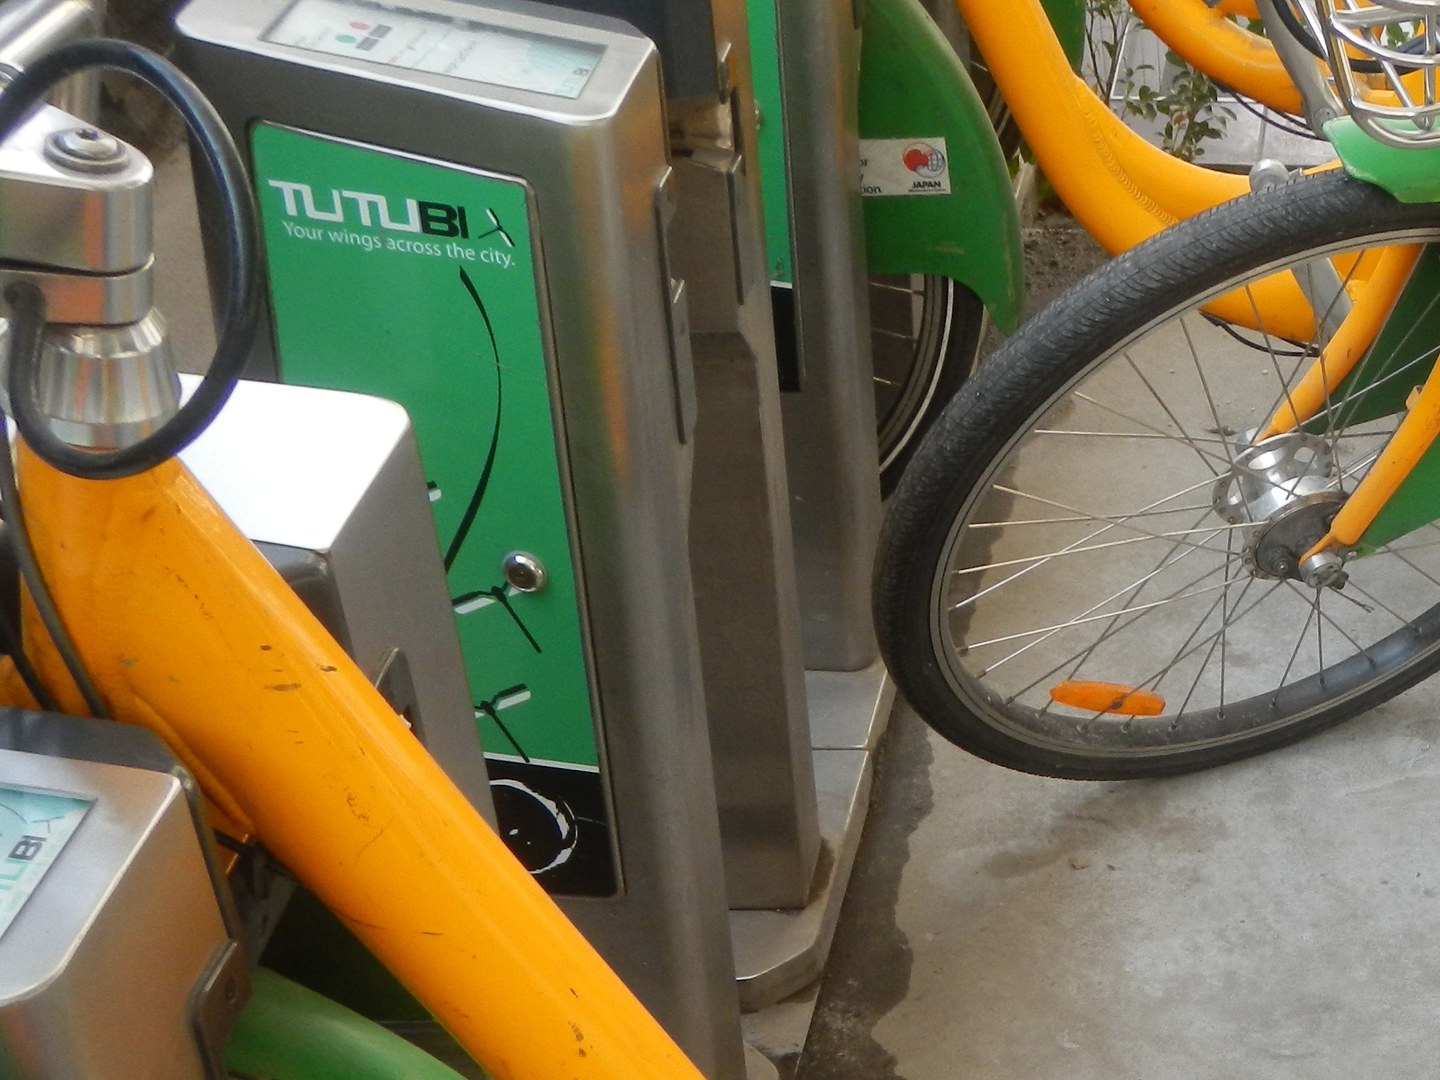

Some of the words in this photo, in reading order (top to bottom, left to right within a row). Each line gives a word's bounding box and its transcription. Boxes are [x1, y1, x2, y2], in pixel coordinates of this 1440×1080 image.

[268, 179, 469, 239] TUTUBI
[912, 180, 942, 189] JAPAN
[283, 220, 329, 240] Your
[329, 229, 382, 251] wings
[386, 238, 441, 257] across
[446, 242, 475, 261] the
[480, 248, 515, 269] city.
